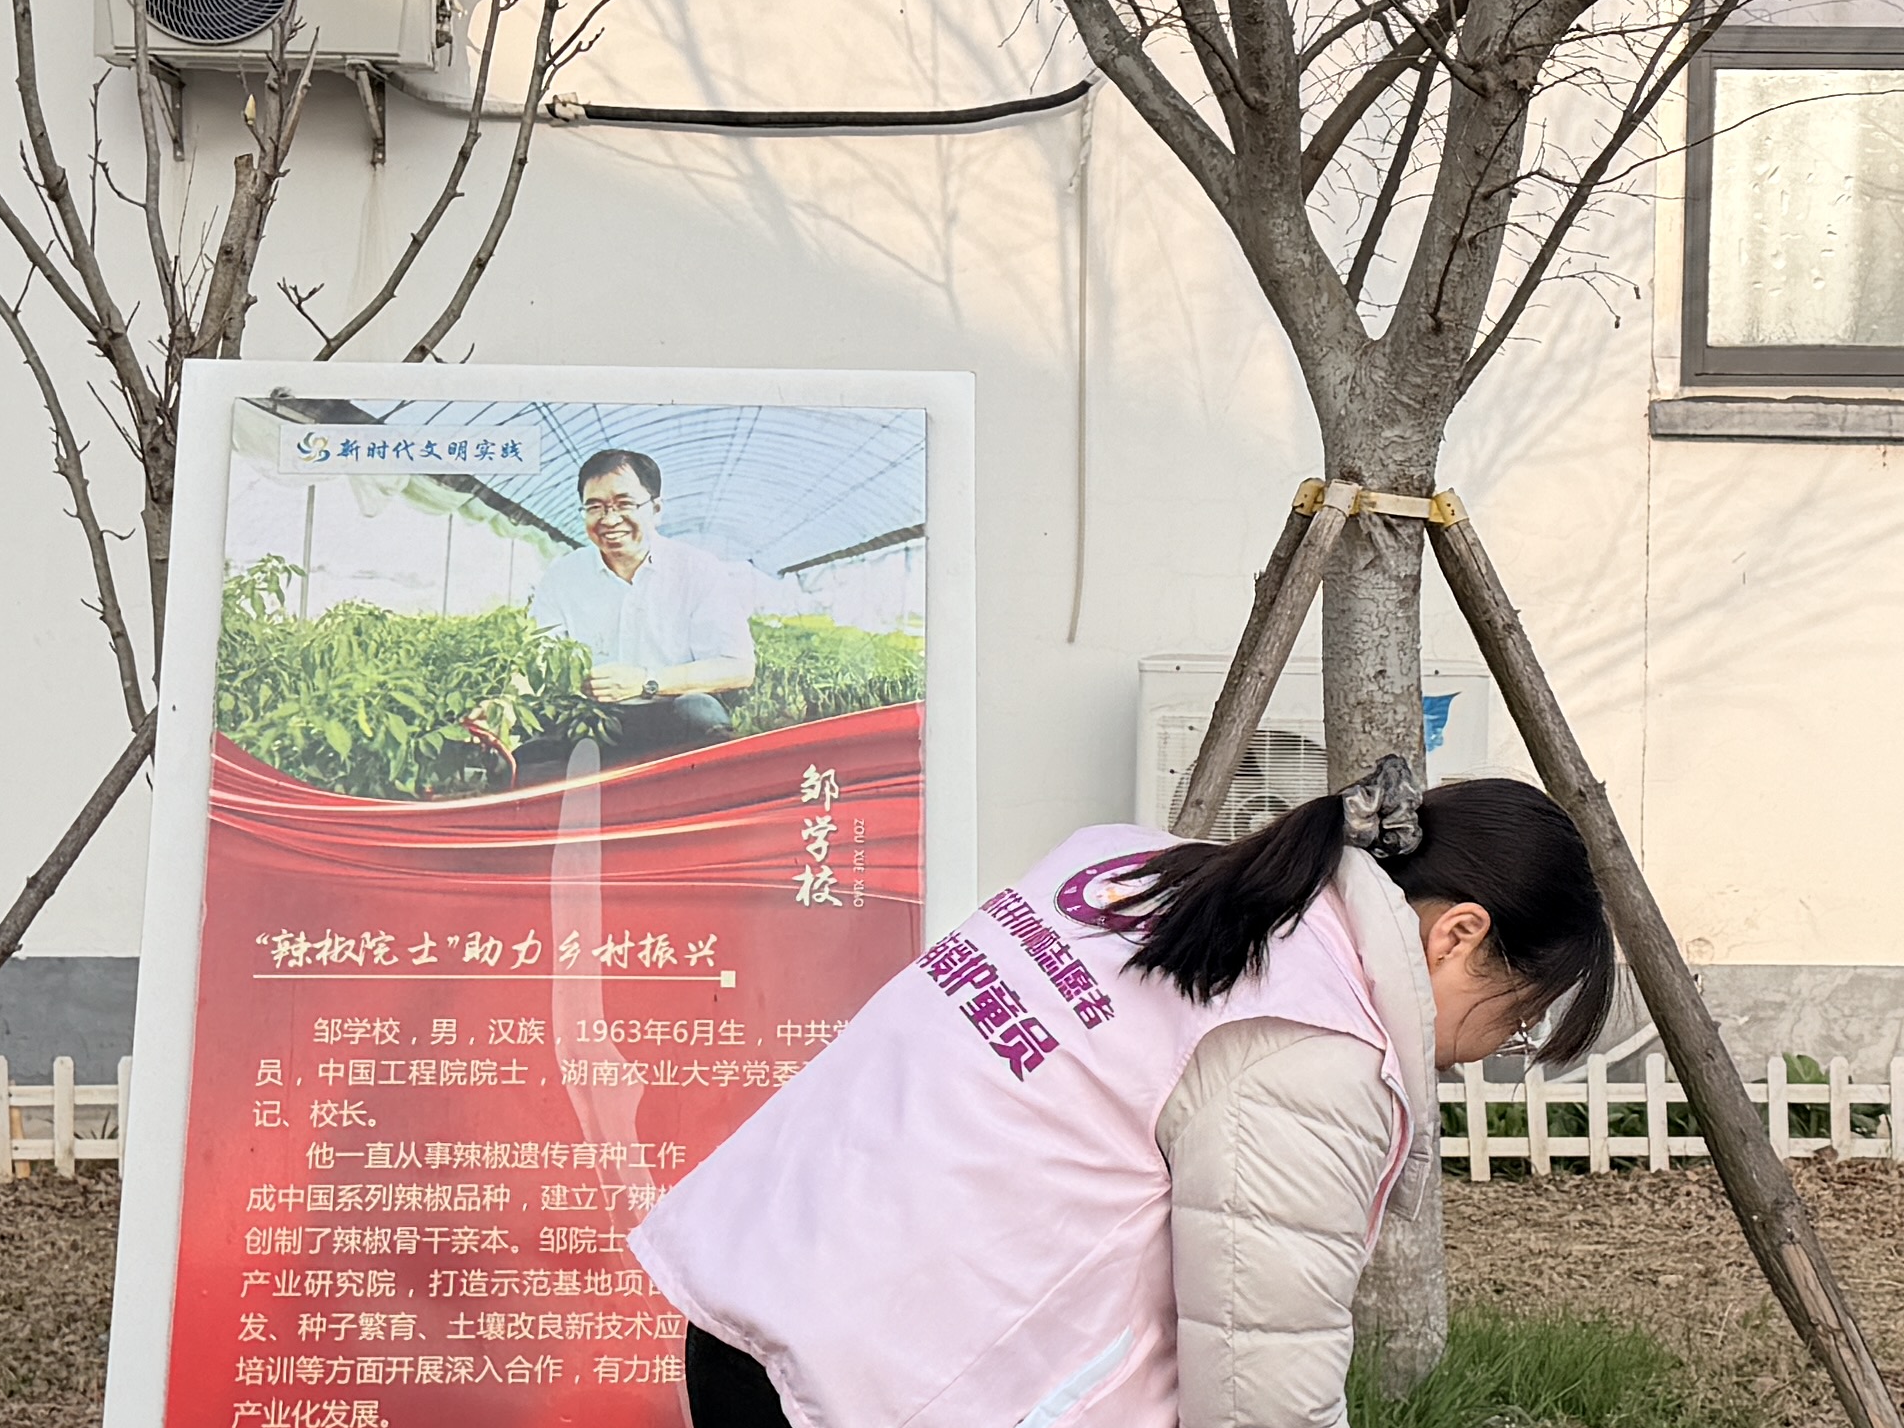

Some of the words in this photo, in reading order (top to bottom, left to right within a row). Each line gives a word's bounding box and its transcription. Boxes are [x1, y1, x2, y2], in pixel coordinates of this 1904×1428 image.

[336, 438, 524, 462] 新时代文明实践
[792, 763, 843, 907] 邹学校
[853, 818, 865, 843] ZOU
[853, 849, 865, 873] XUE
[853, 879, 865, 908] XIAO
[254, 1058, 809, 1088] 员，中国工程院院士，湖南农业大学党委
[246, 1183, 672, 1213] 成中国系列辣椒品种，建立了辣
